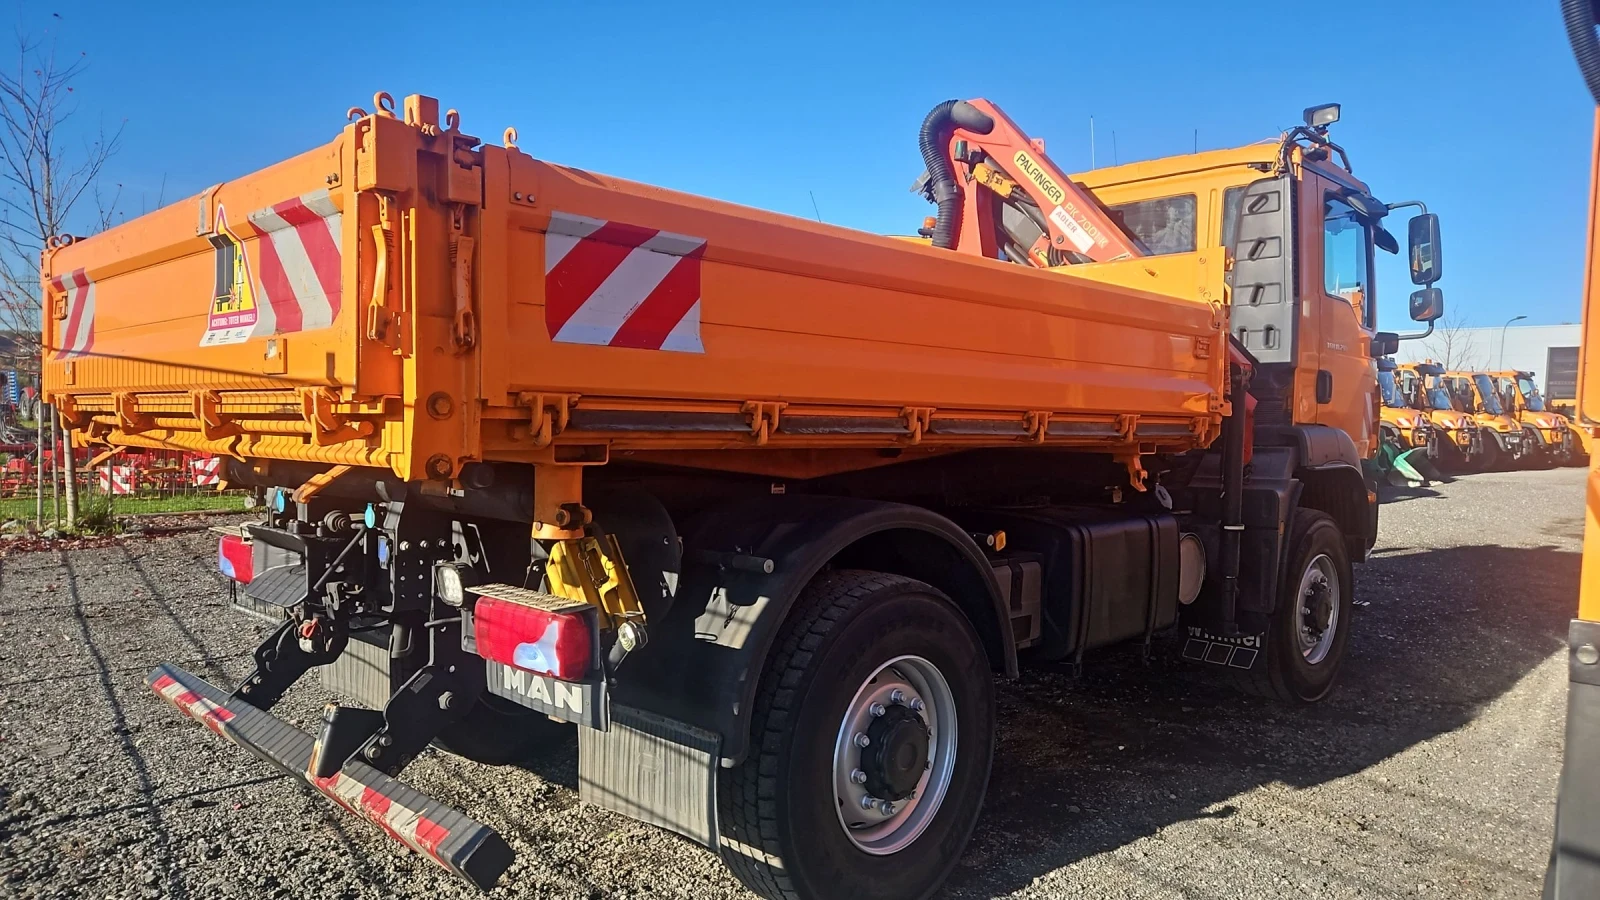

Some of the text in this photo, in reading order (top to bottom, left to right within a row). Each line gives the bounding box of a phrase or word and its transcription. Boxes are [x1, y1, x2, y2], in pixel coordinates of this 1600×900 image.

[1016, 153, 1062, 202] PALFINGER
[1055, 211, 1078, 233] ADLER
[1064, 202, 1080, 218] PK
[503, 664, 583, 714] MAN
